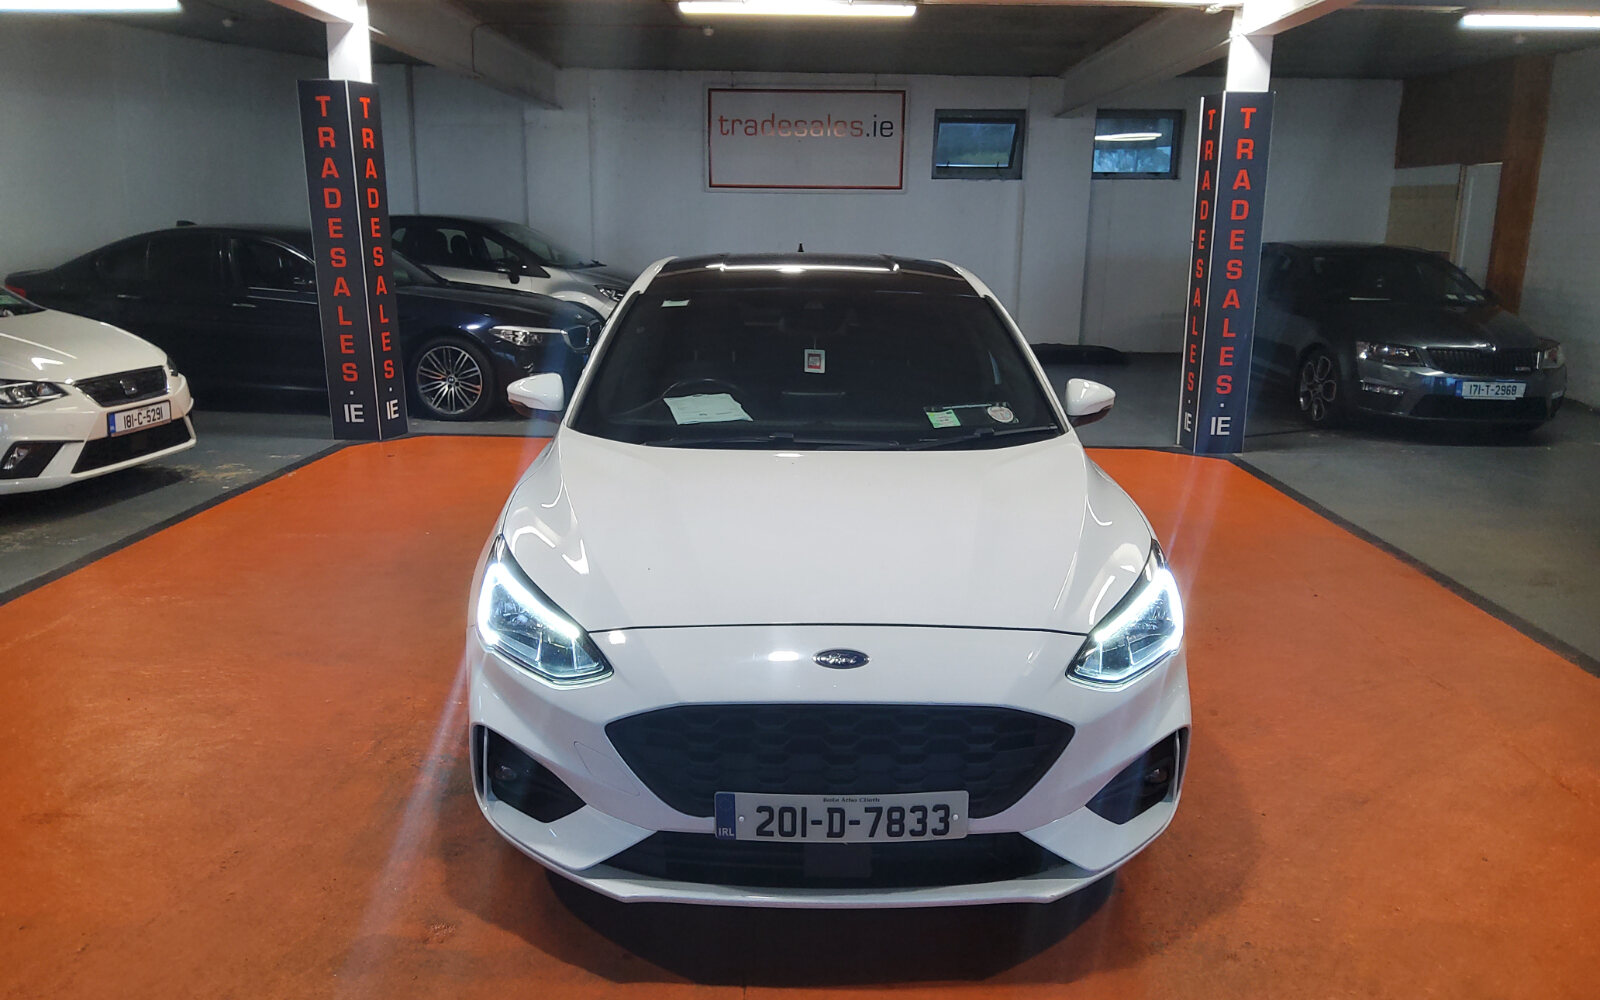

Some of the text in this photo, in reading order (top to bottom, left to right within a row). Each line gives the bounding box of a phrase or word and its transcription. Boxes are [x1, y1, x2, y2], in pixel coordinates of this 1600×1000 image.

[718, 112, 894, 138] tradesales.ie
[123, 405, 164, 429] 181-C-5291
[718, 827, 735, 837] IRL
[755, 804, 951, 839] 201-D-7833
